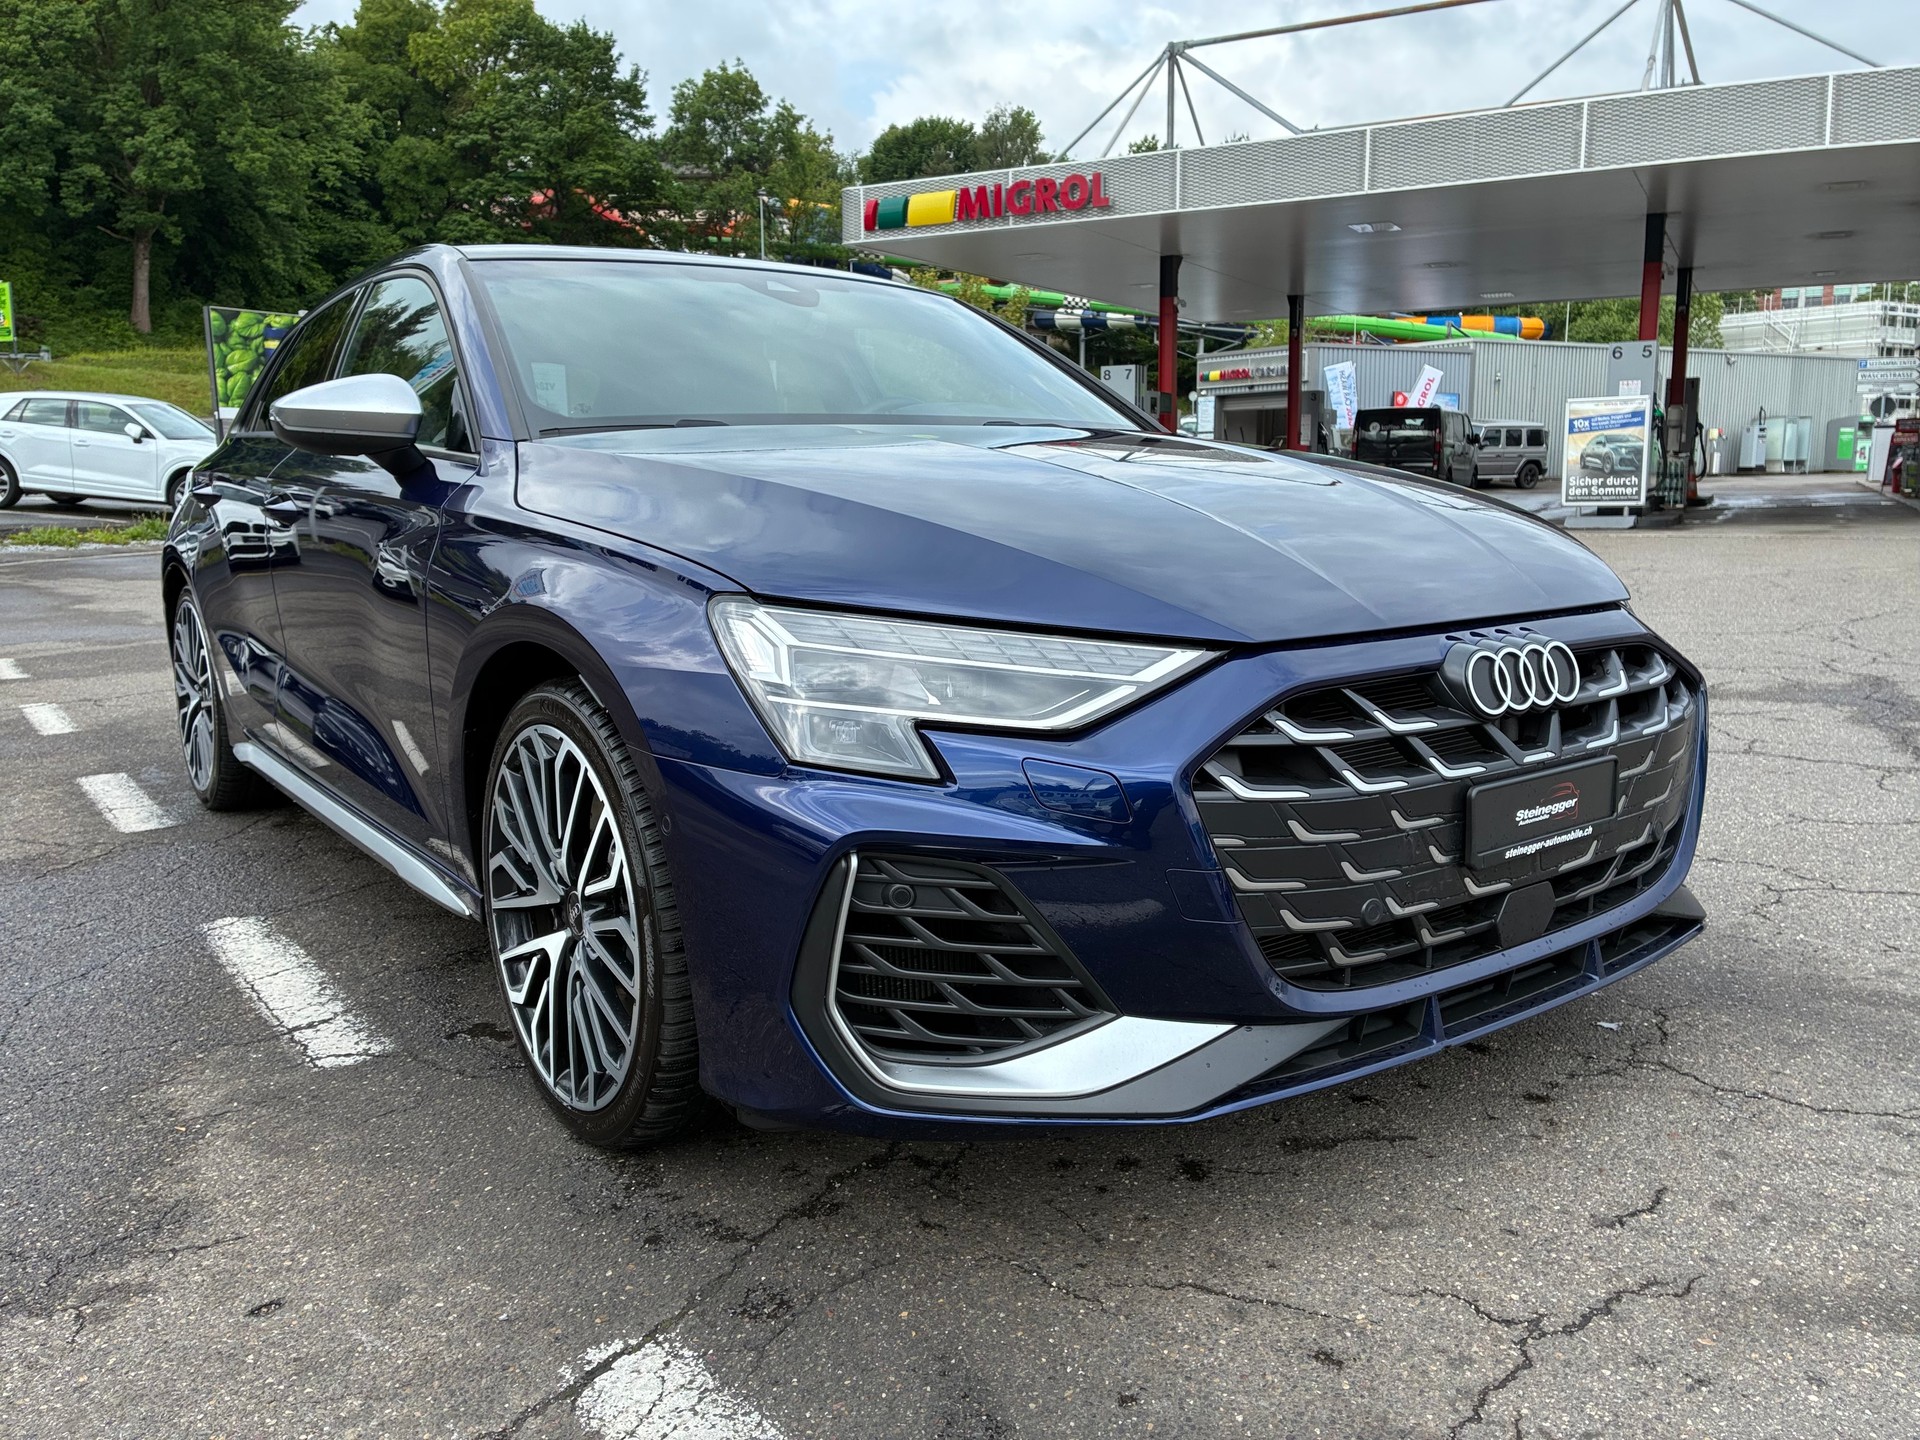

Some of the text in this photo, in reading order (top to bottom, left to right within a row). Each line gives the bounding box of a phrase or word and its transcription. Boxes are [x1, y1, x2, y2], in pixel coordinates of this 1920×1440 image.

[957, 172, 1110, 221] MIGROL
[1612, 344, 1653, 360] 6 5
[1103, 368, 1132, 381] 8 7
[1220, 368, 1252, 380] MIGROL
[1310, 392, 1317, 401] 3
[1573, 419, 1590, 429] 10x
[1568, 475, 1638, 486] Sicher durch
[1568, 486, 1639, 496] den Sommer
[1515, 798, 1578, 821] Steinegger
[1518, 814, 1550, 827] Automobile
[1505, 825, 1593, 859] steinegger-automobile.ch
